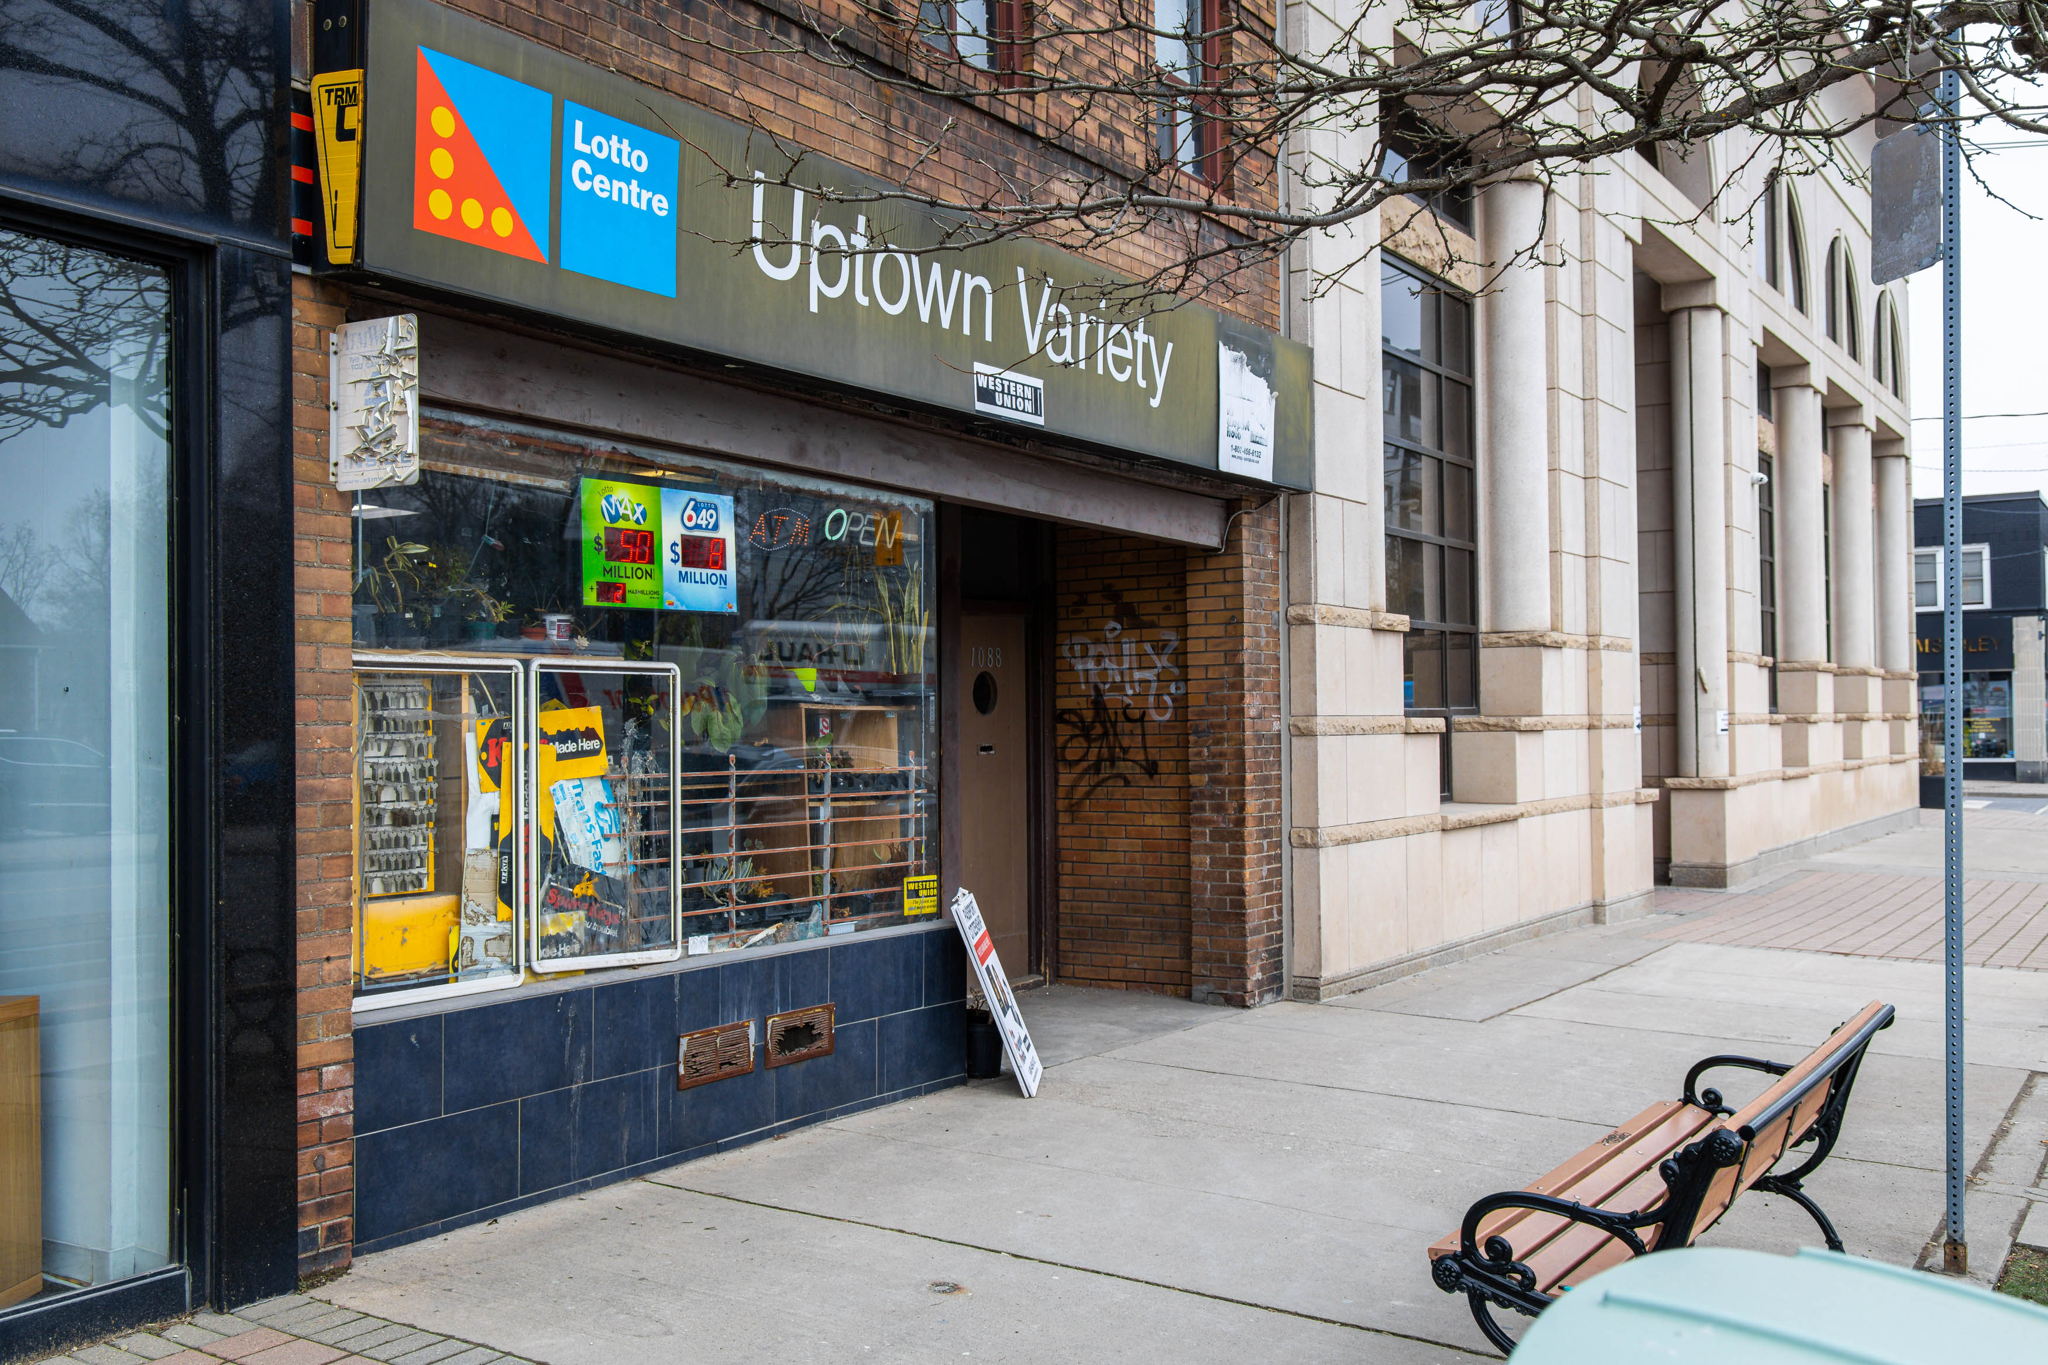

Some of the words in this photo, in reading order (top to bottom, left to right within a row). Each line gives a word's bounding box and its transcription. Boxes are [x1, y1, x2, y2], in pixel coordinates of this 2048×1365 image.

[574, 119, 648, 173] Lotto
[571, 159, 669, 216] Centre
[752, 170, 992, 342] Uptown
[1016, 266, 1173, 408] Variety
[976, 373, 1033, 400] WESTERN
[995, 392, 1033, 413] UNION
[597, 485, 614, 496] Lotto
[601, 494, 646, 524] MAX
[749, 513, 811, 547] ATM
[824, 508, 899, 549] OPEN
[620, 530, 651, 564] 50
[603, 565, 653, 581] MILLION
[678, 570, 728, 586] MILLION
[971, 647, 1001, 668] 1088
[578, 738, 600, 752] Here
